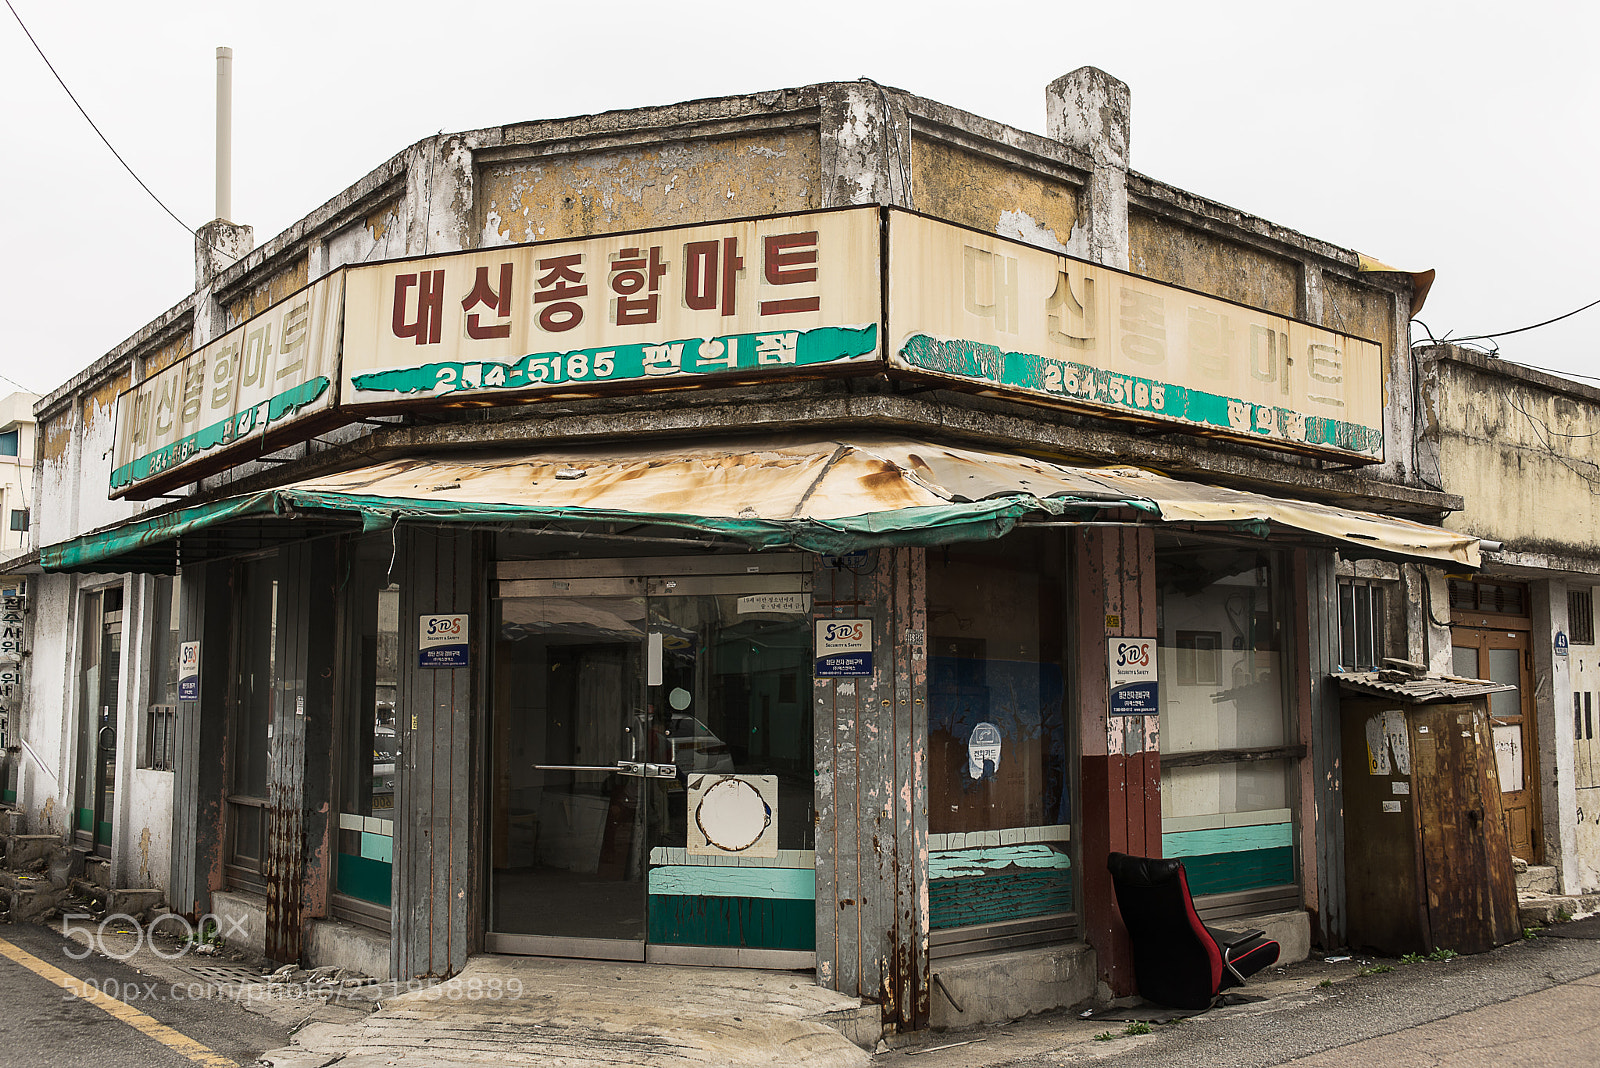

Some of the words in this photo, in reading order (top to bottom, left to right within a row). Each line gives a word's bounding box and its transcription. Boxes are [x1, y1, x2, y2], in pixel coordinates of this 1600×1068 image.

[391, 231, 820, 346] 대신종합마트
[642, 332, 800, 375] 편의점
[964, 244, 1345, 407] 대신종합마트
[132, 301, 309, 447] 대신종합마트
